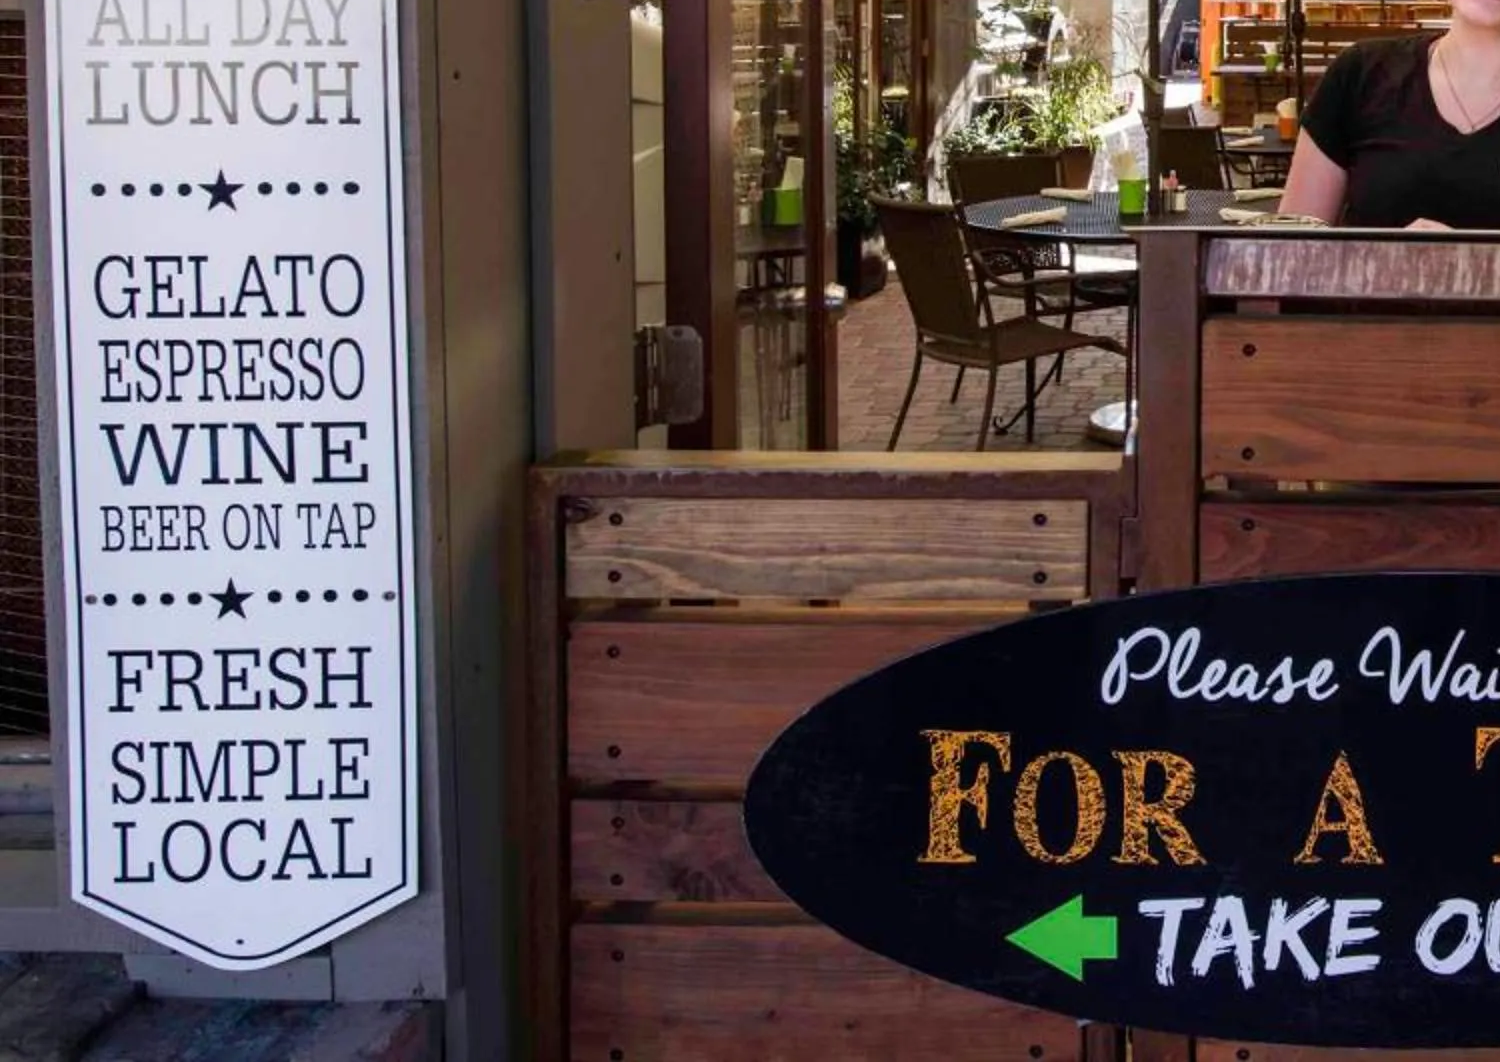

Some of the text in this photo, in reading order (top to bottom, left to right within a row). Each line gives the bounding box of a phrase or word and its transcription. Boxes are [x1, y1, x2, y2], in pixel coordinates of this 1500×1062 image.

[86, 61, 361, 126] LUNCH
[94, 253, 365, 320] GELATO
[98, 337, 365, 403] ESPRESSO
[99, 421, 369, 487] WINE
[99, 502, 376, 552] BEER ON TAP
[107, 646, 373, 713] FRESH
[1101, 627, 1339, 704] Please
[111, 737, 370, 805] SIMPLE
[112, 817, 372, 884] LOCAL
[1138, 895, 1383, 990] TAKE
